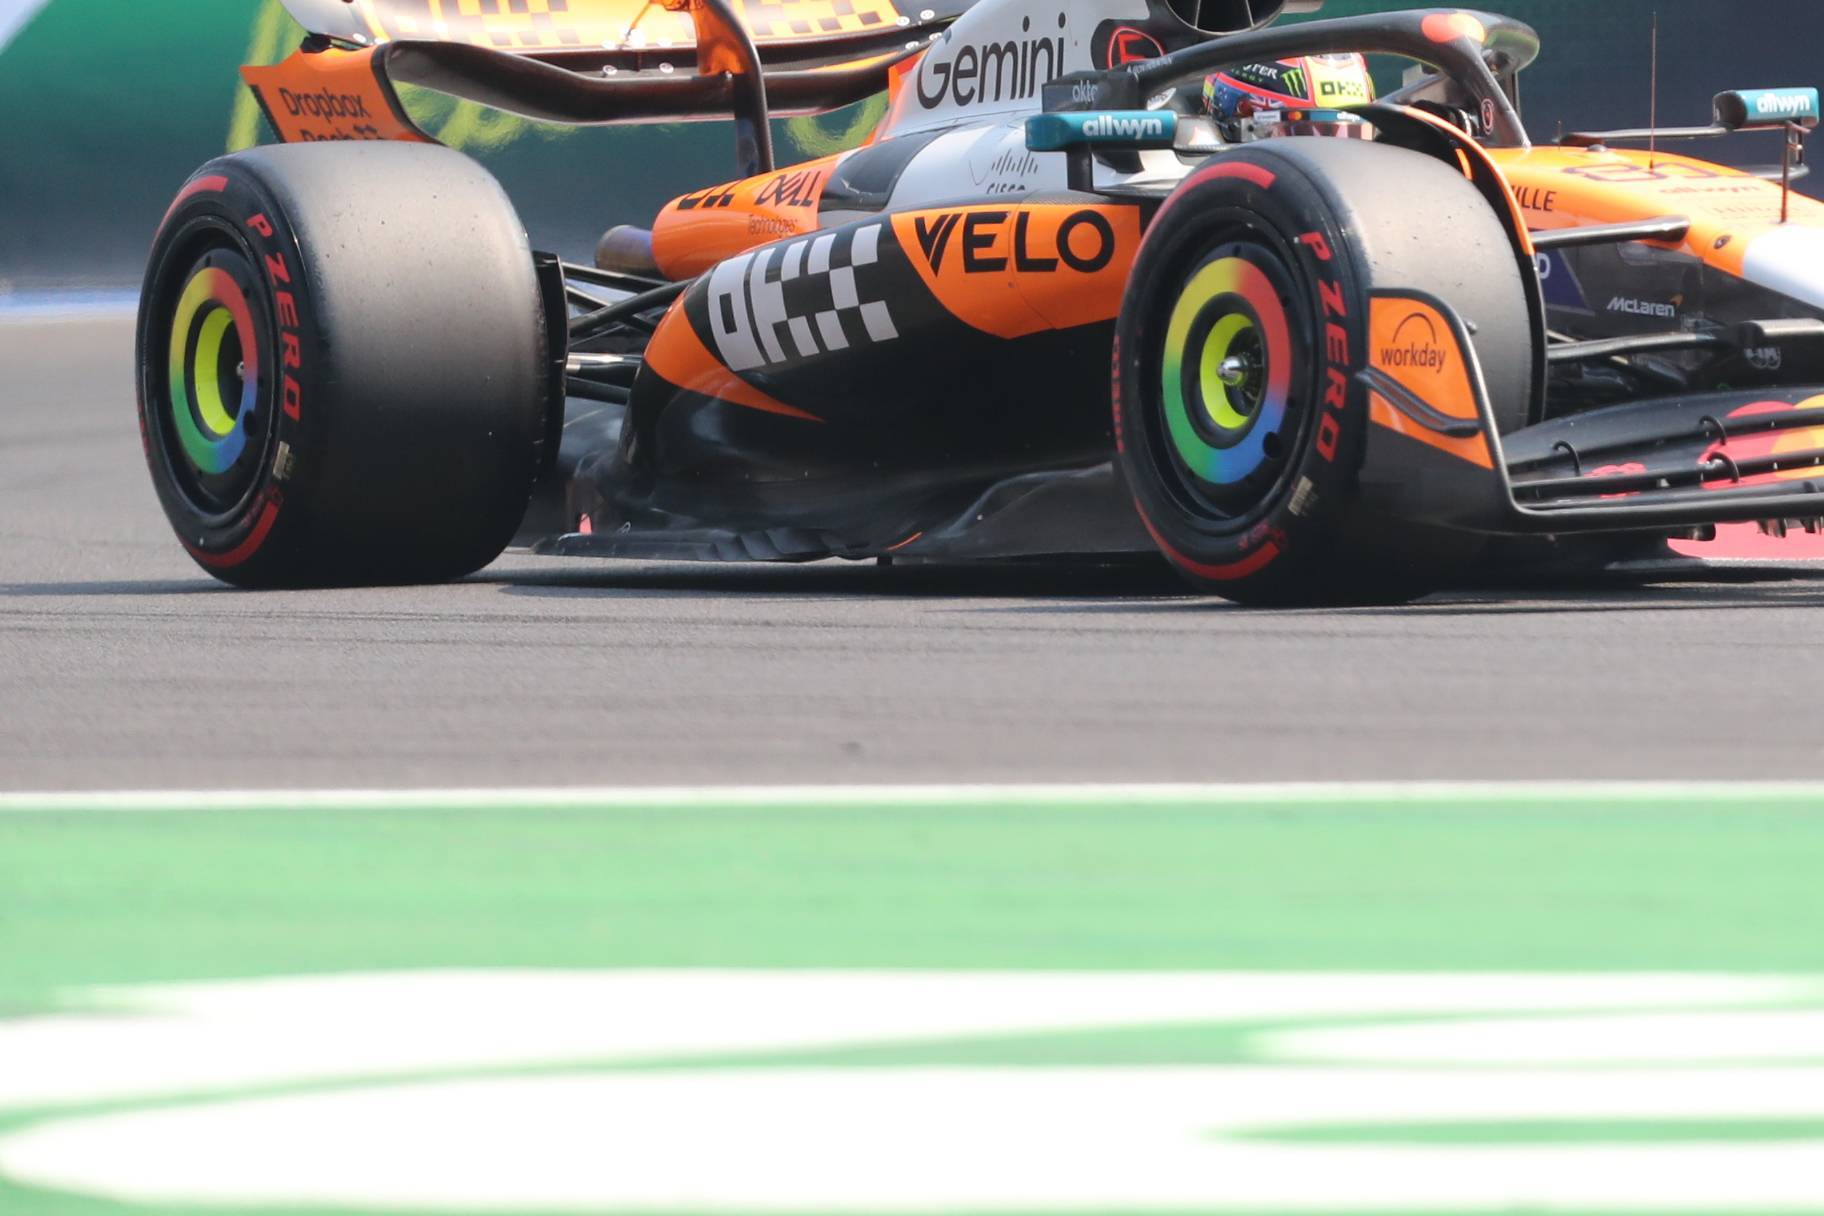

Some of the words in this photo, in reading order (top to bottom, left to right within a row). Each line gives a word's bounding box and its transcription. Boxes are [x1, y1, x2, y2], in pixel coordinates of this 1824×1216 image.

[917, 11, 1067, 111] Gemini
[279, 87, 371, 124] Dropbox
[1757, 92, 1811, 116] allwyn
[1082, 115, 1162, 140] allwyn
[754, 171, 821, 207] DELL
[1510, 185, 1557, 212] ILLE
[914, 209, 1115, 277] VELO
[1300, 231, 1332, 261] P
[246, 213, 273, 238] P
[264, 252, 301, 421] ZERO
[1606, 295, 1676, 318] McLaren
[1315, 279, 1350, 463] ZERO
[1380, 342, 1446, 375] workday
